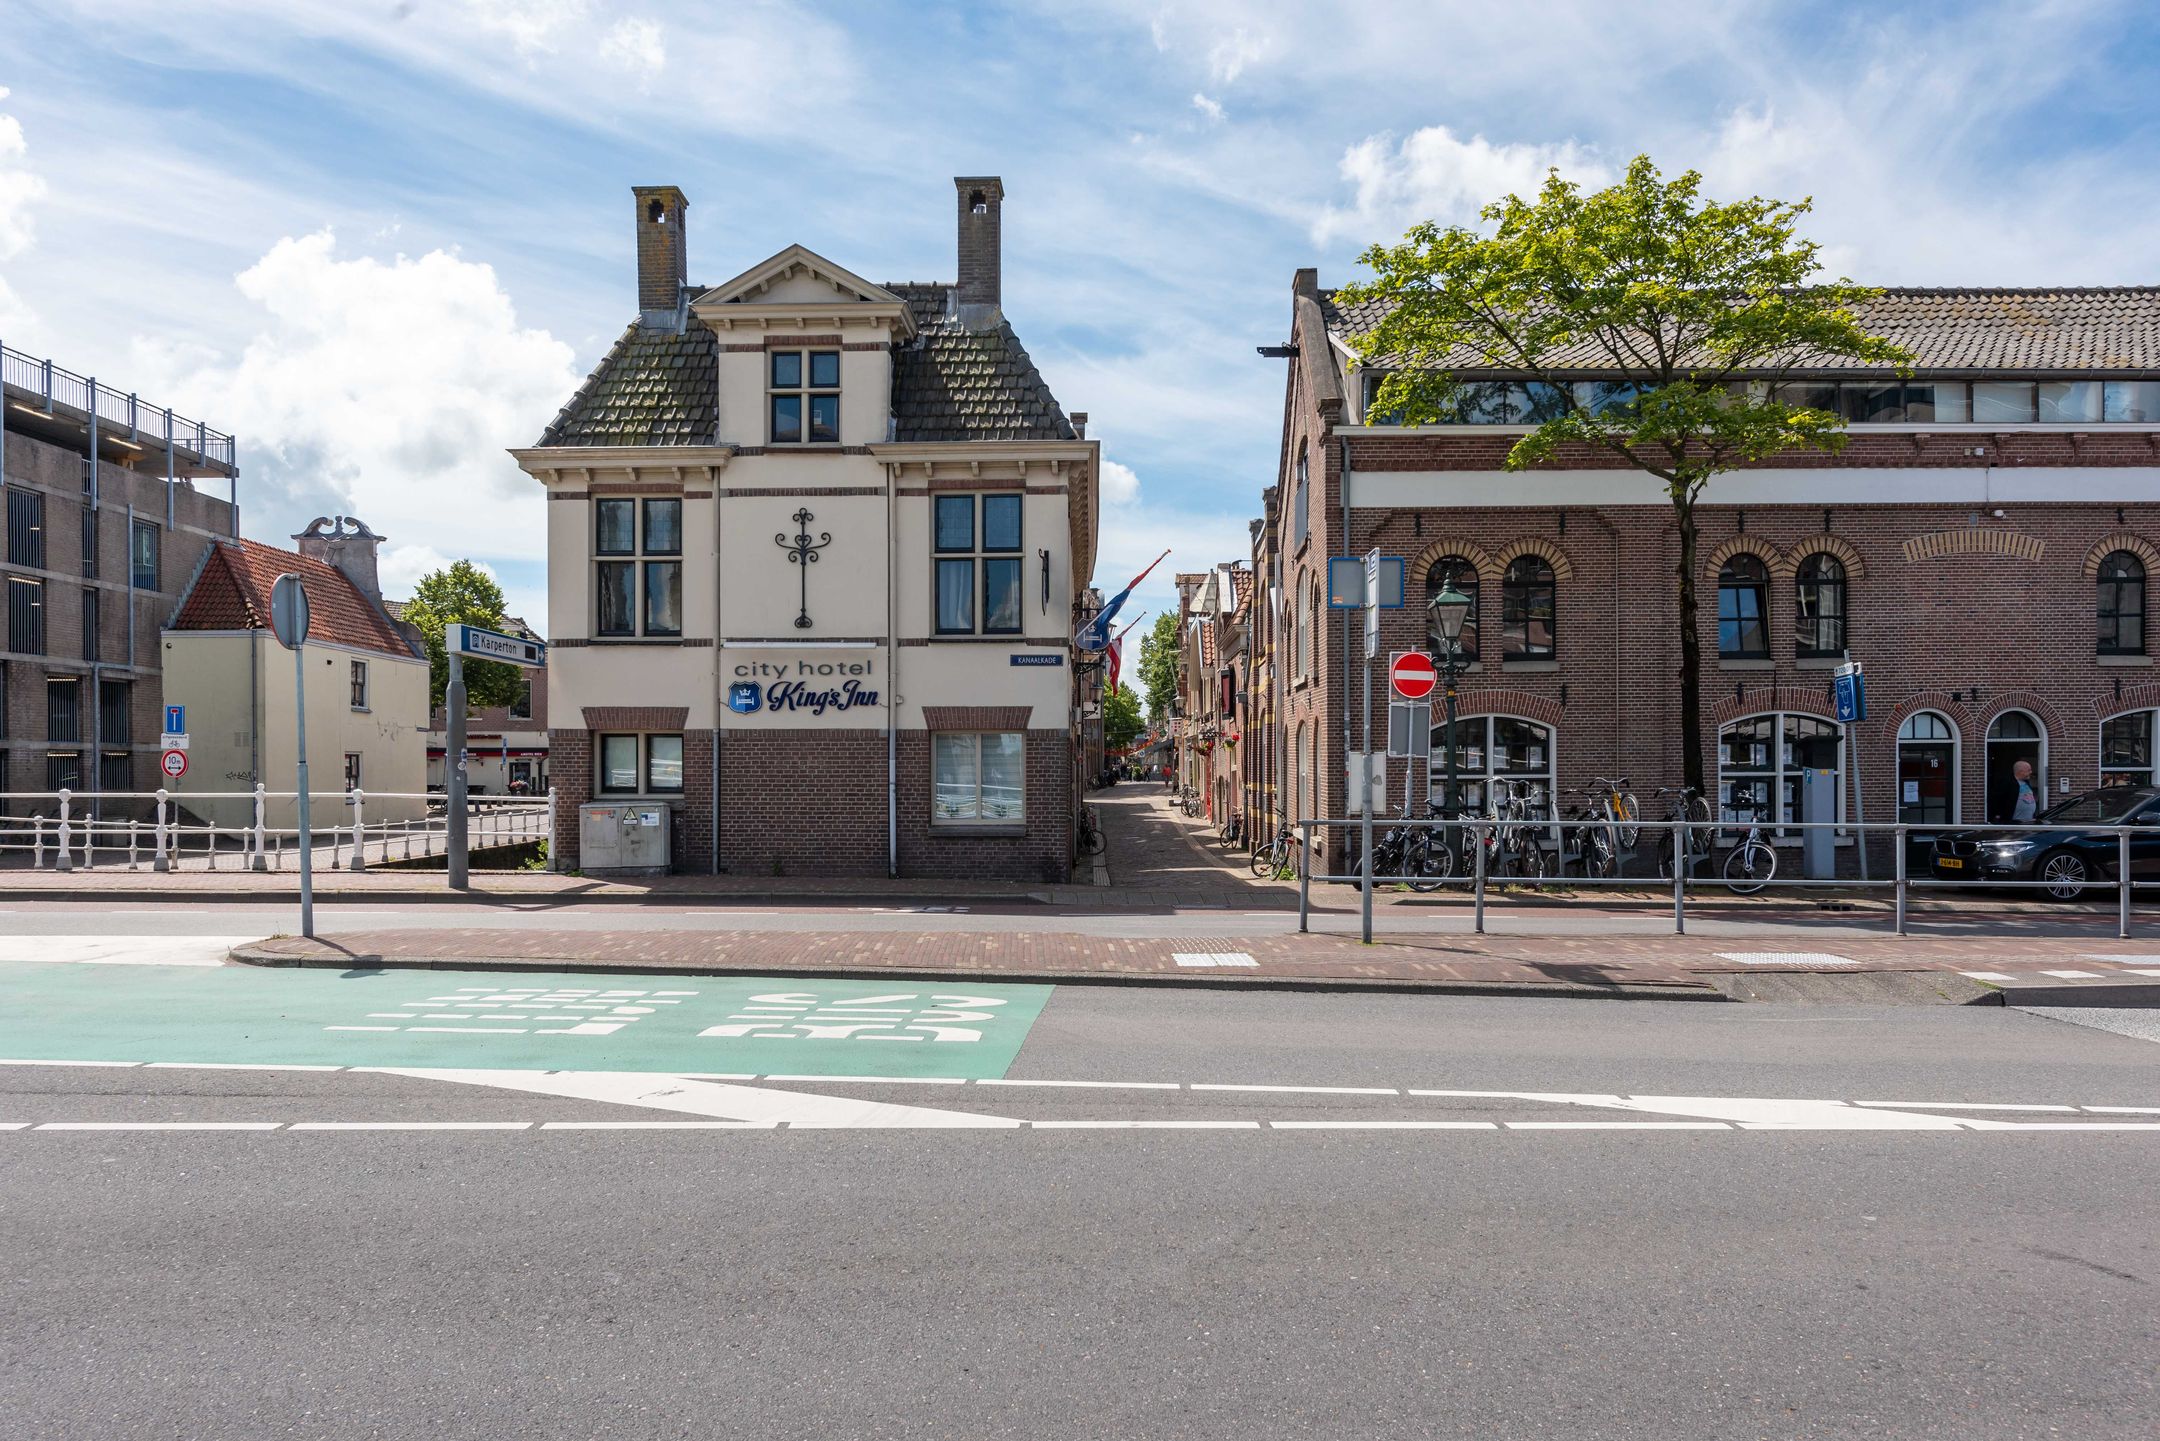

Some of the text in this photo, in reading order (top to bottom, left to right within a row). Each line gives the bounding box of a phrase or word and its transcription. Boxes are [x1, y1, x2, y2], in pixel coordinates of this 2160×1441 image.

[481, 635, 517, 655] Karperton
[734, 660, 872, 680] city hotel
[766, 679, 879, 716] King's Inn
[1930, 759, 1939, 768] 16
